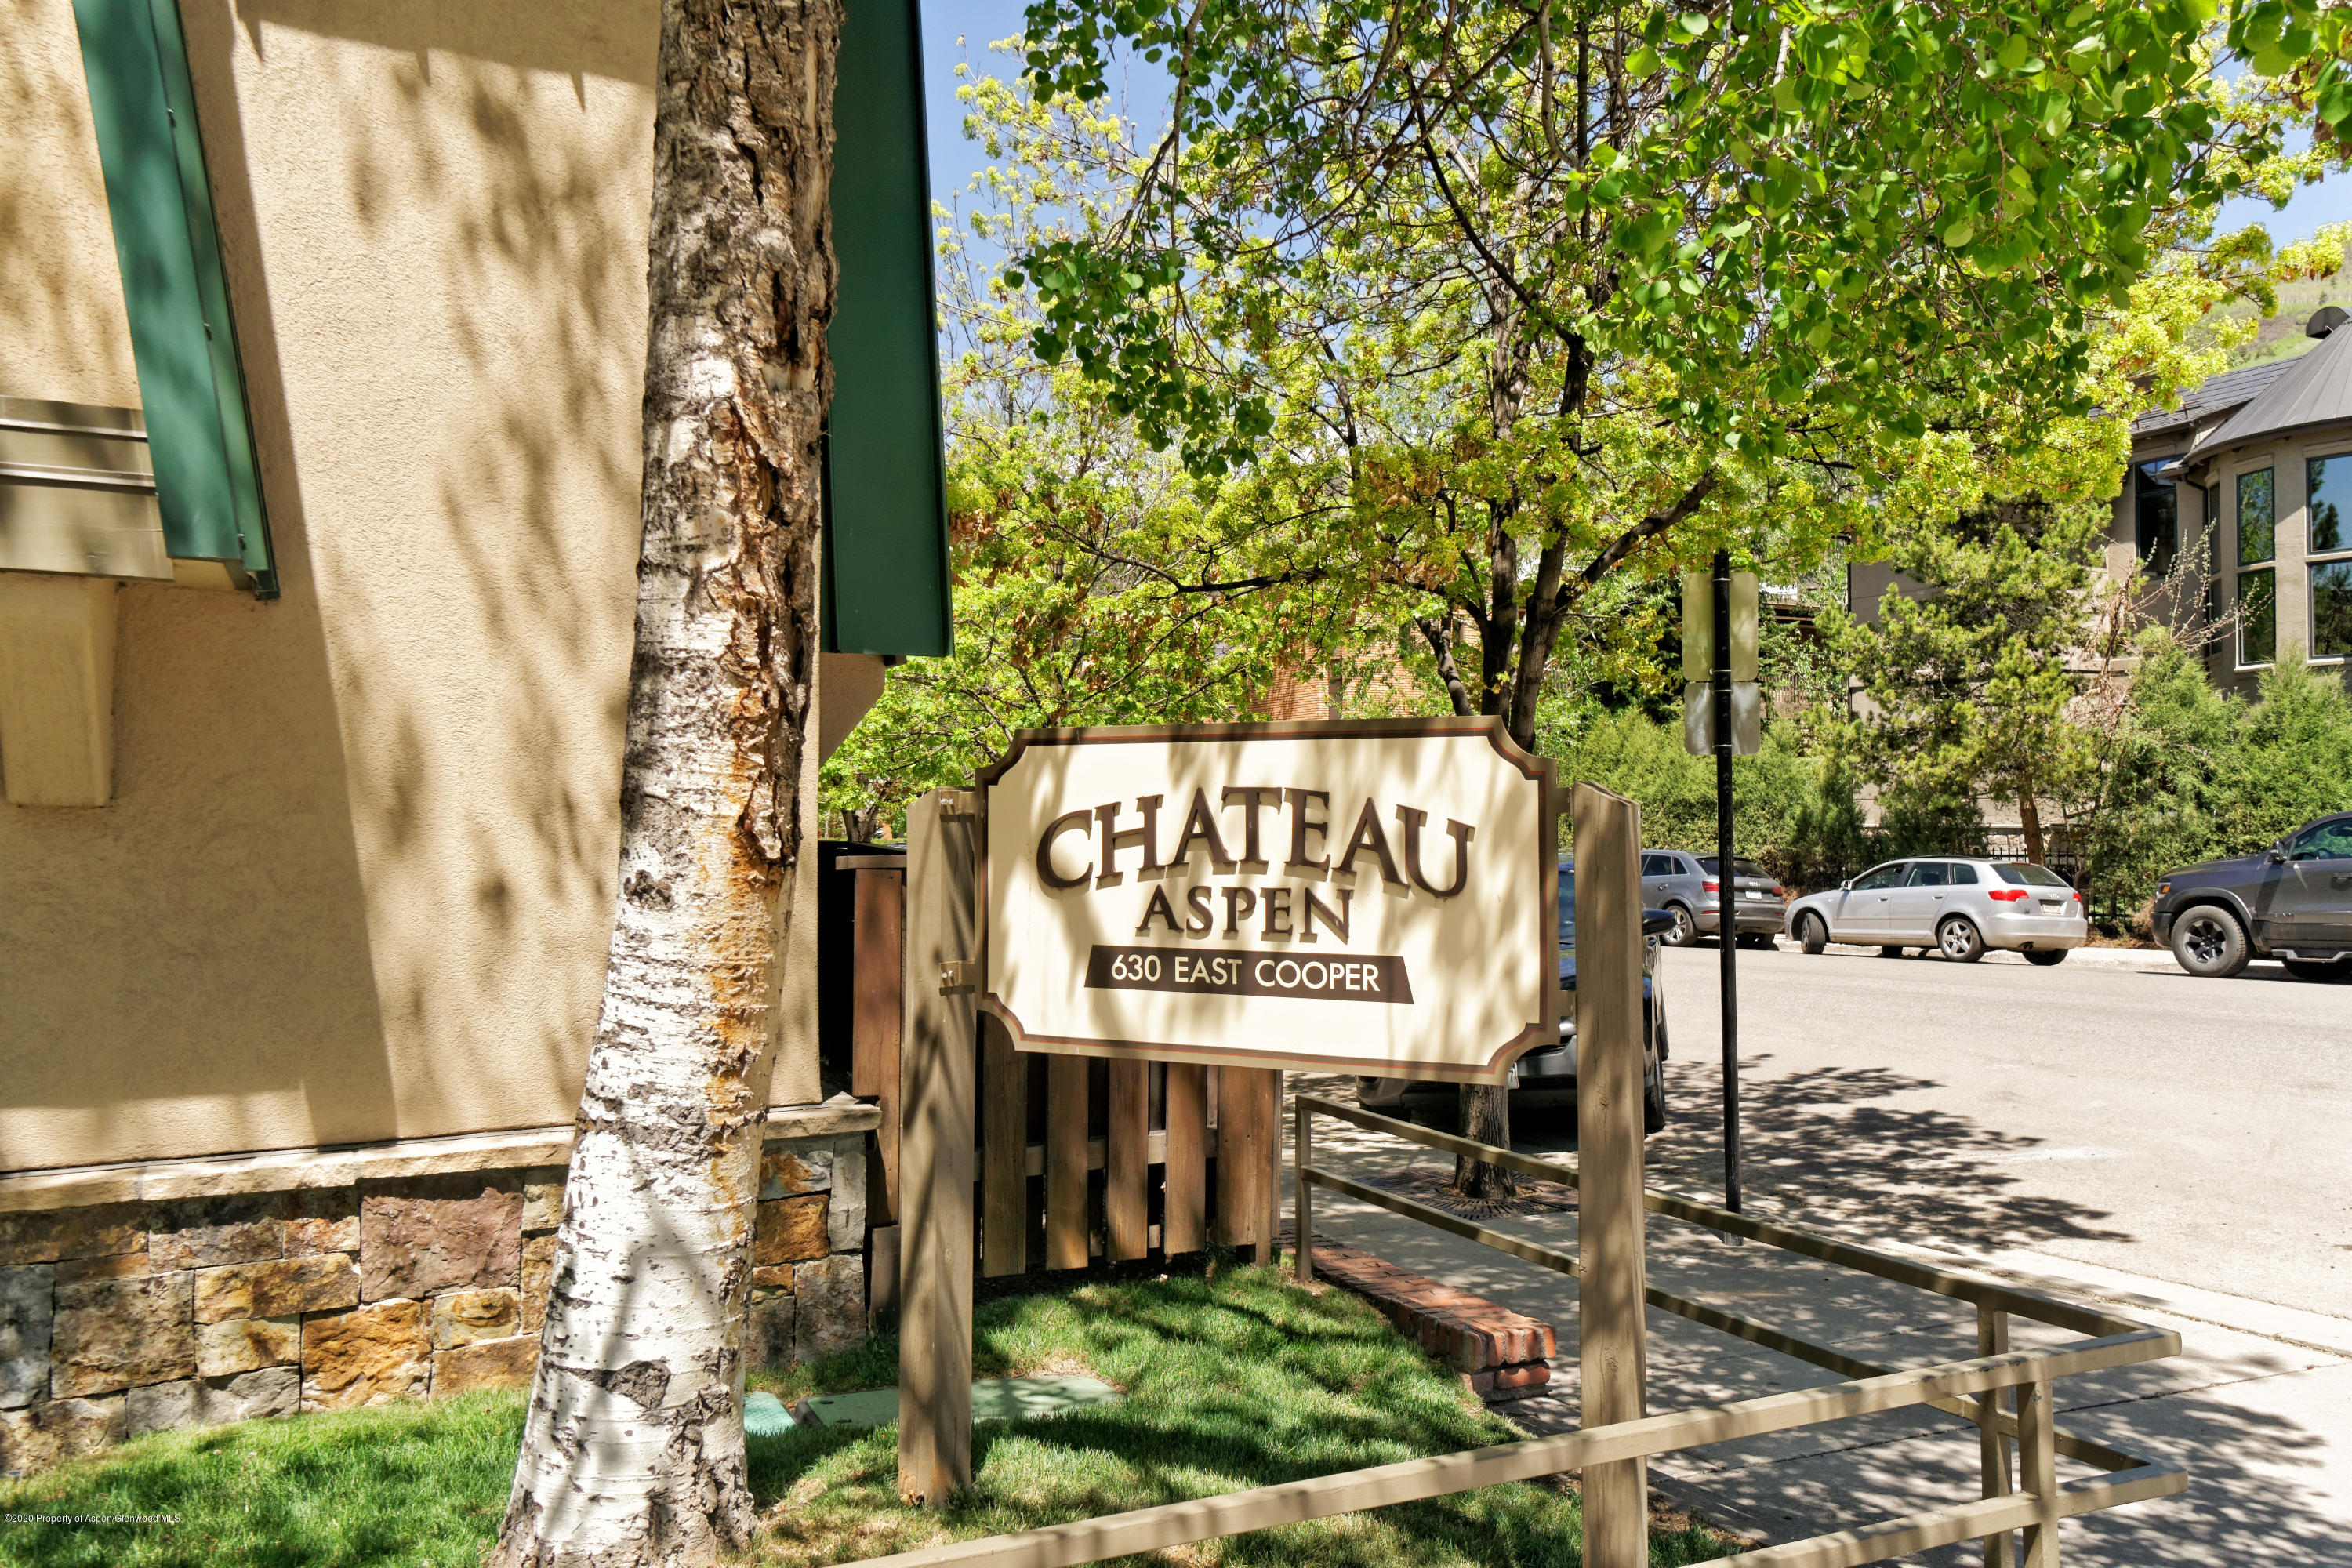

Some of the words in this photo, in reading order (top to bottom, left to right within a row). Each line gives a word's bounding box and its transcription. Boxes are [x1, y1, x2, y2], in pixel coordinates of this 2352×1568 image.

[1036, 786, 1475, 898] CHATEAU
[1136, 885, 1353, 939] ASPEN
[1111, 954, 1162, 982] 630
[1174, 956, 1243, 985] EAST
[1254, 959, 1381, 993] COOPER
